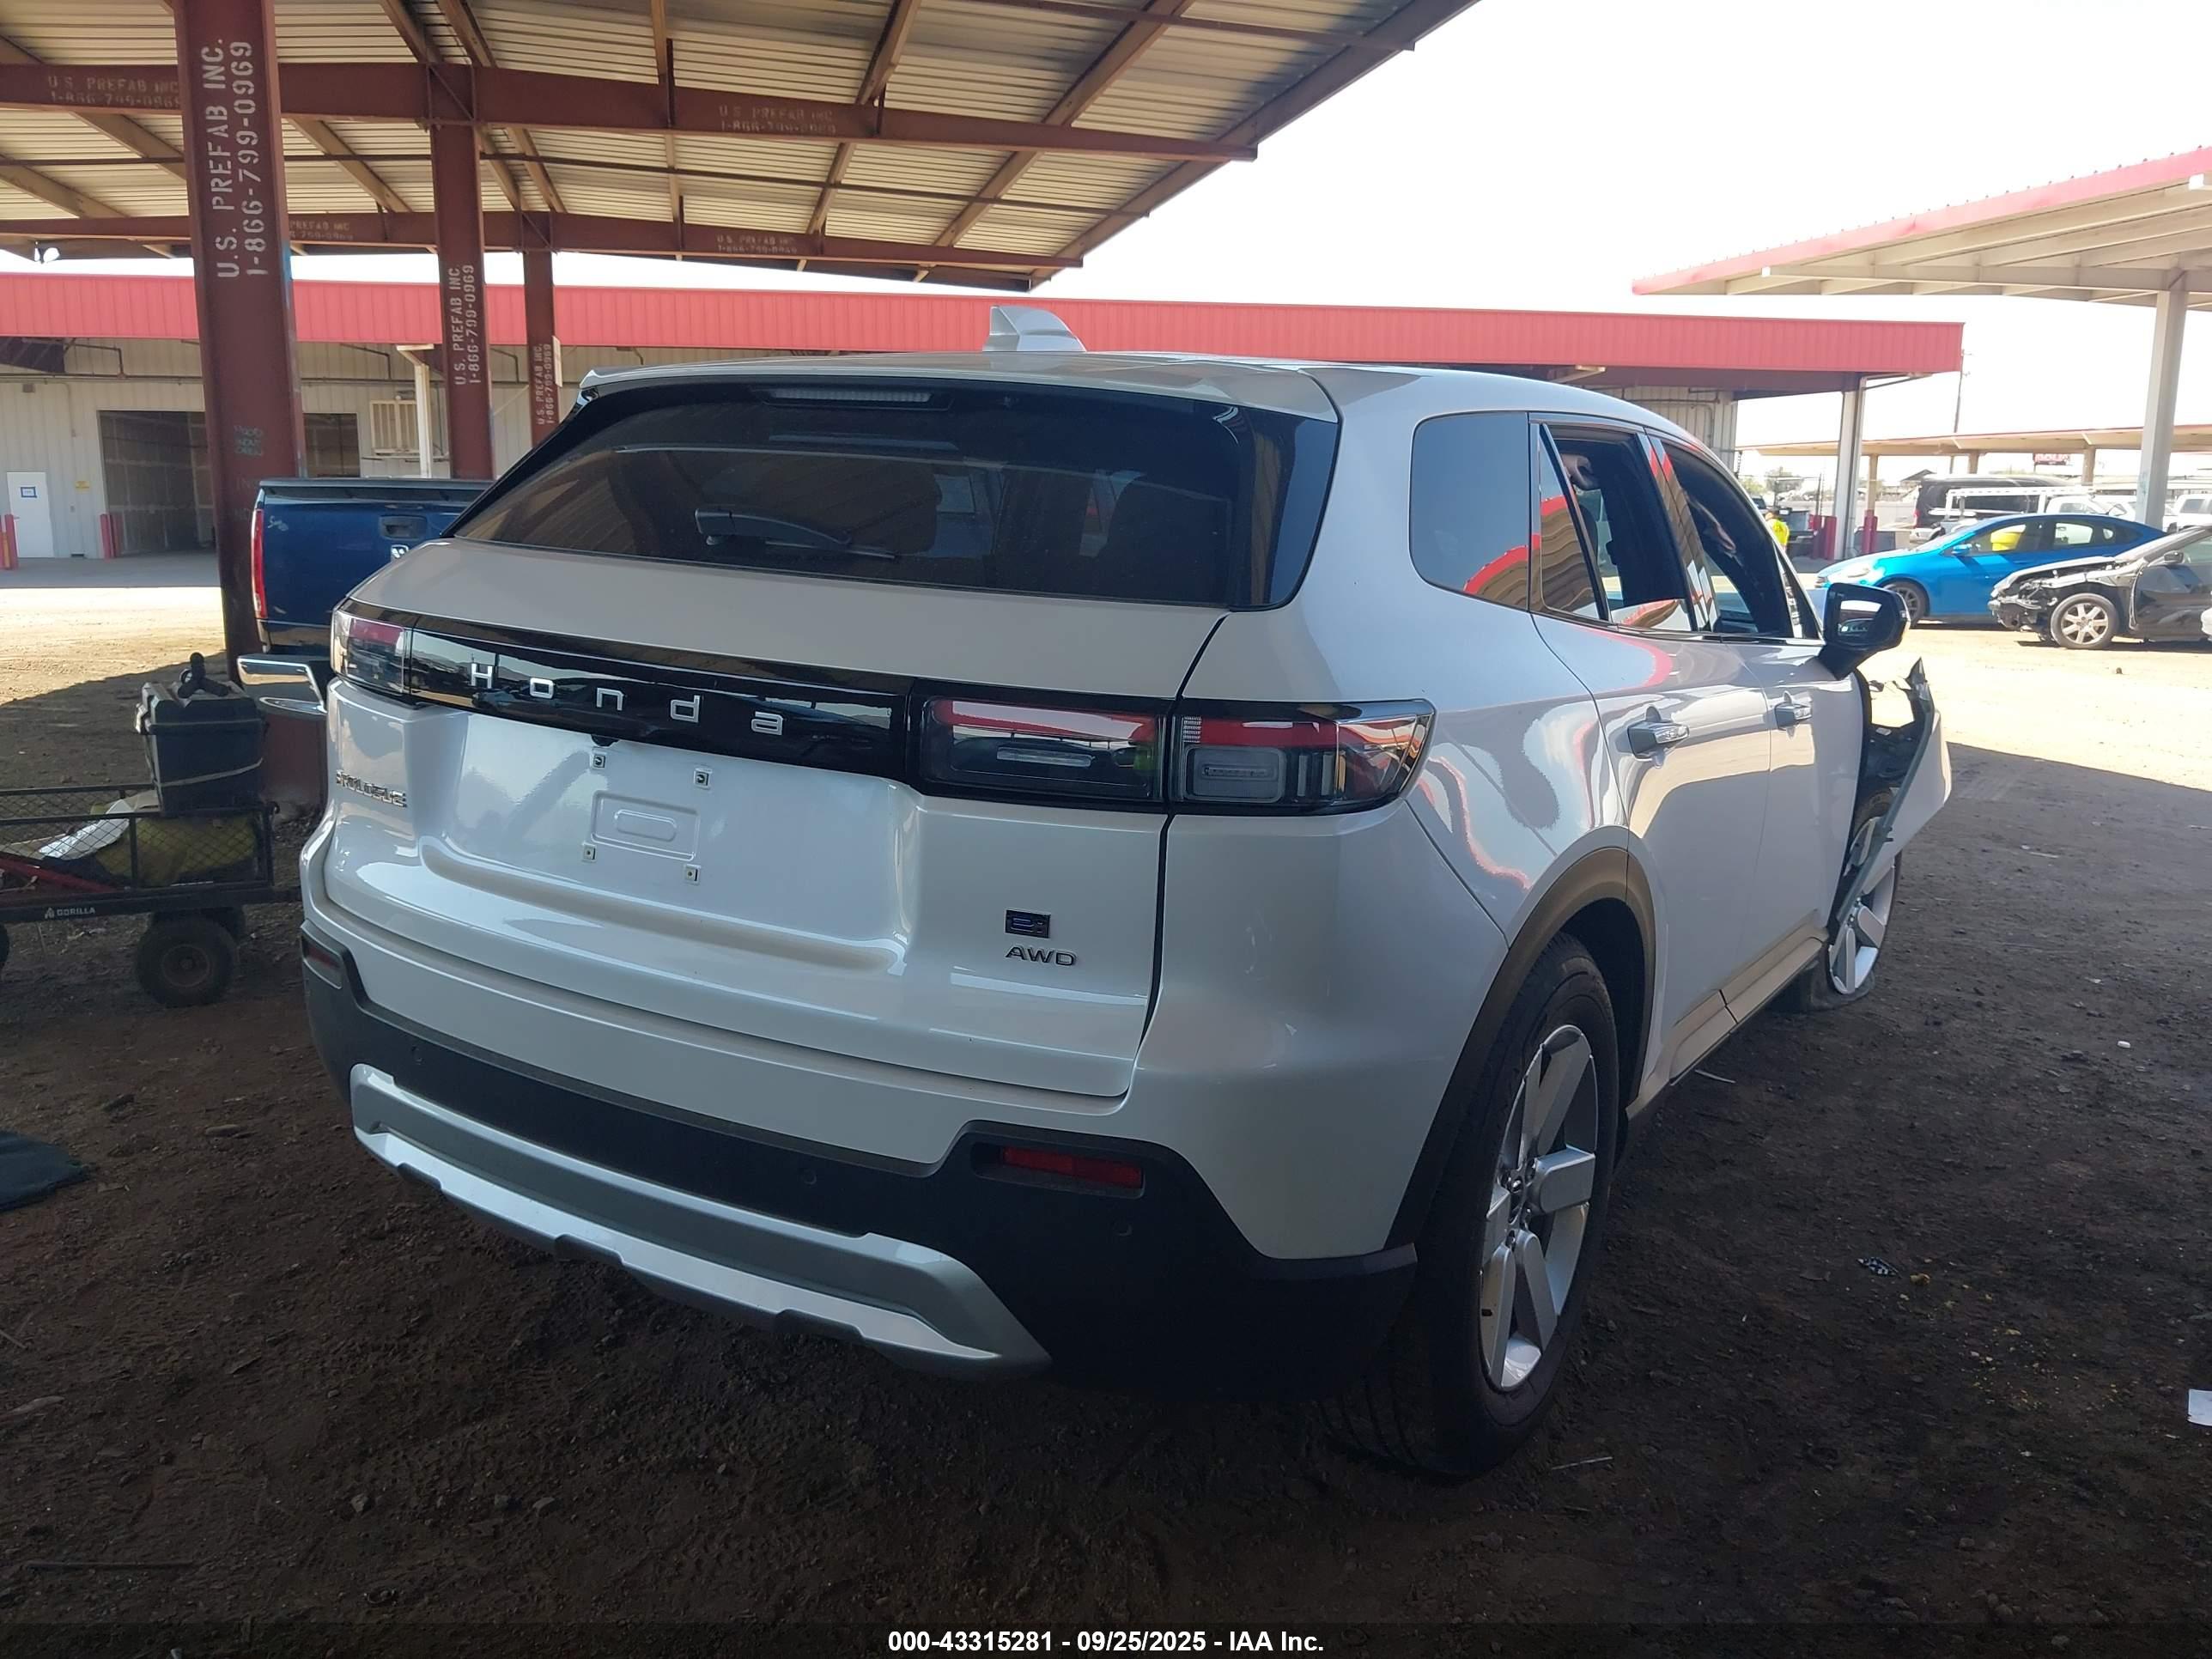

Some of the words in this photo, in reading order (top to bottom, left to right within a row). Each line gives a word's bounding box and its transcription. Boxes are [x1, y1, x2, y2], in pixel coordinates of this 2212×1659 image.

[200, 39, 226, 89] INC.
[205, 105, 234, 210] PREFAB
[229, 41, 268, 276] 1-866-799-0969
[216, 228, 240, 277] U.S.
[449, 296, 465, 352] PREFAB
[462, 264, 482, 385] 1-866-799-0969
[471, 663, 783, 736] Honda
[57, 907, 96, 916] GORILLA
[1005, 944, 1077, 967] AWD
